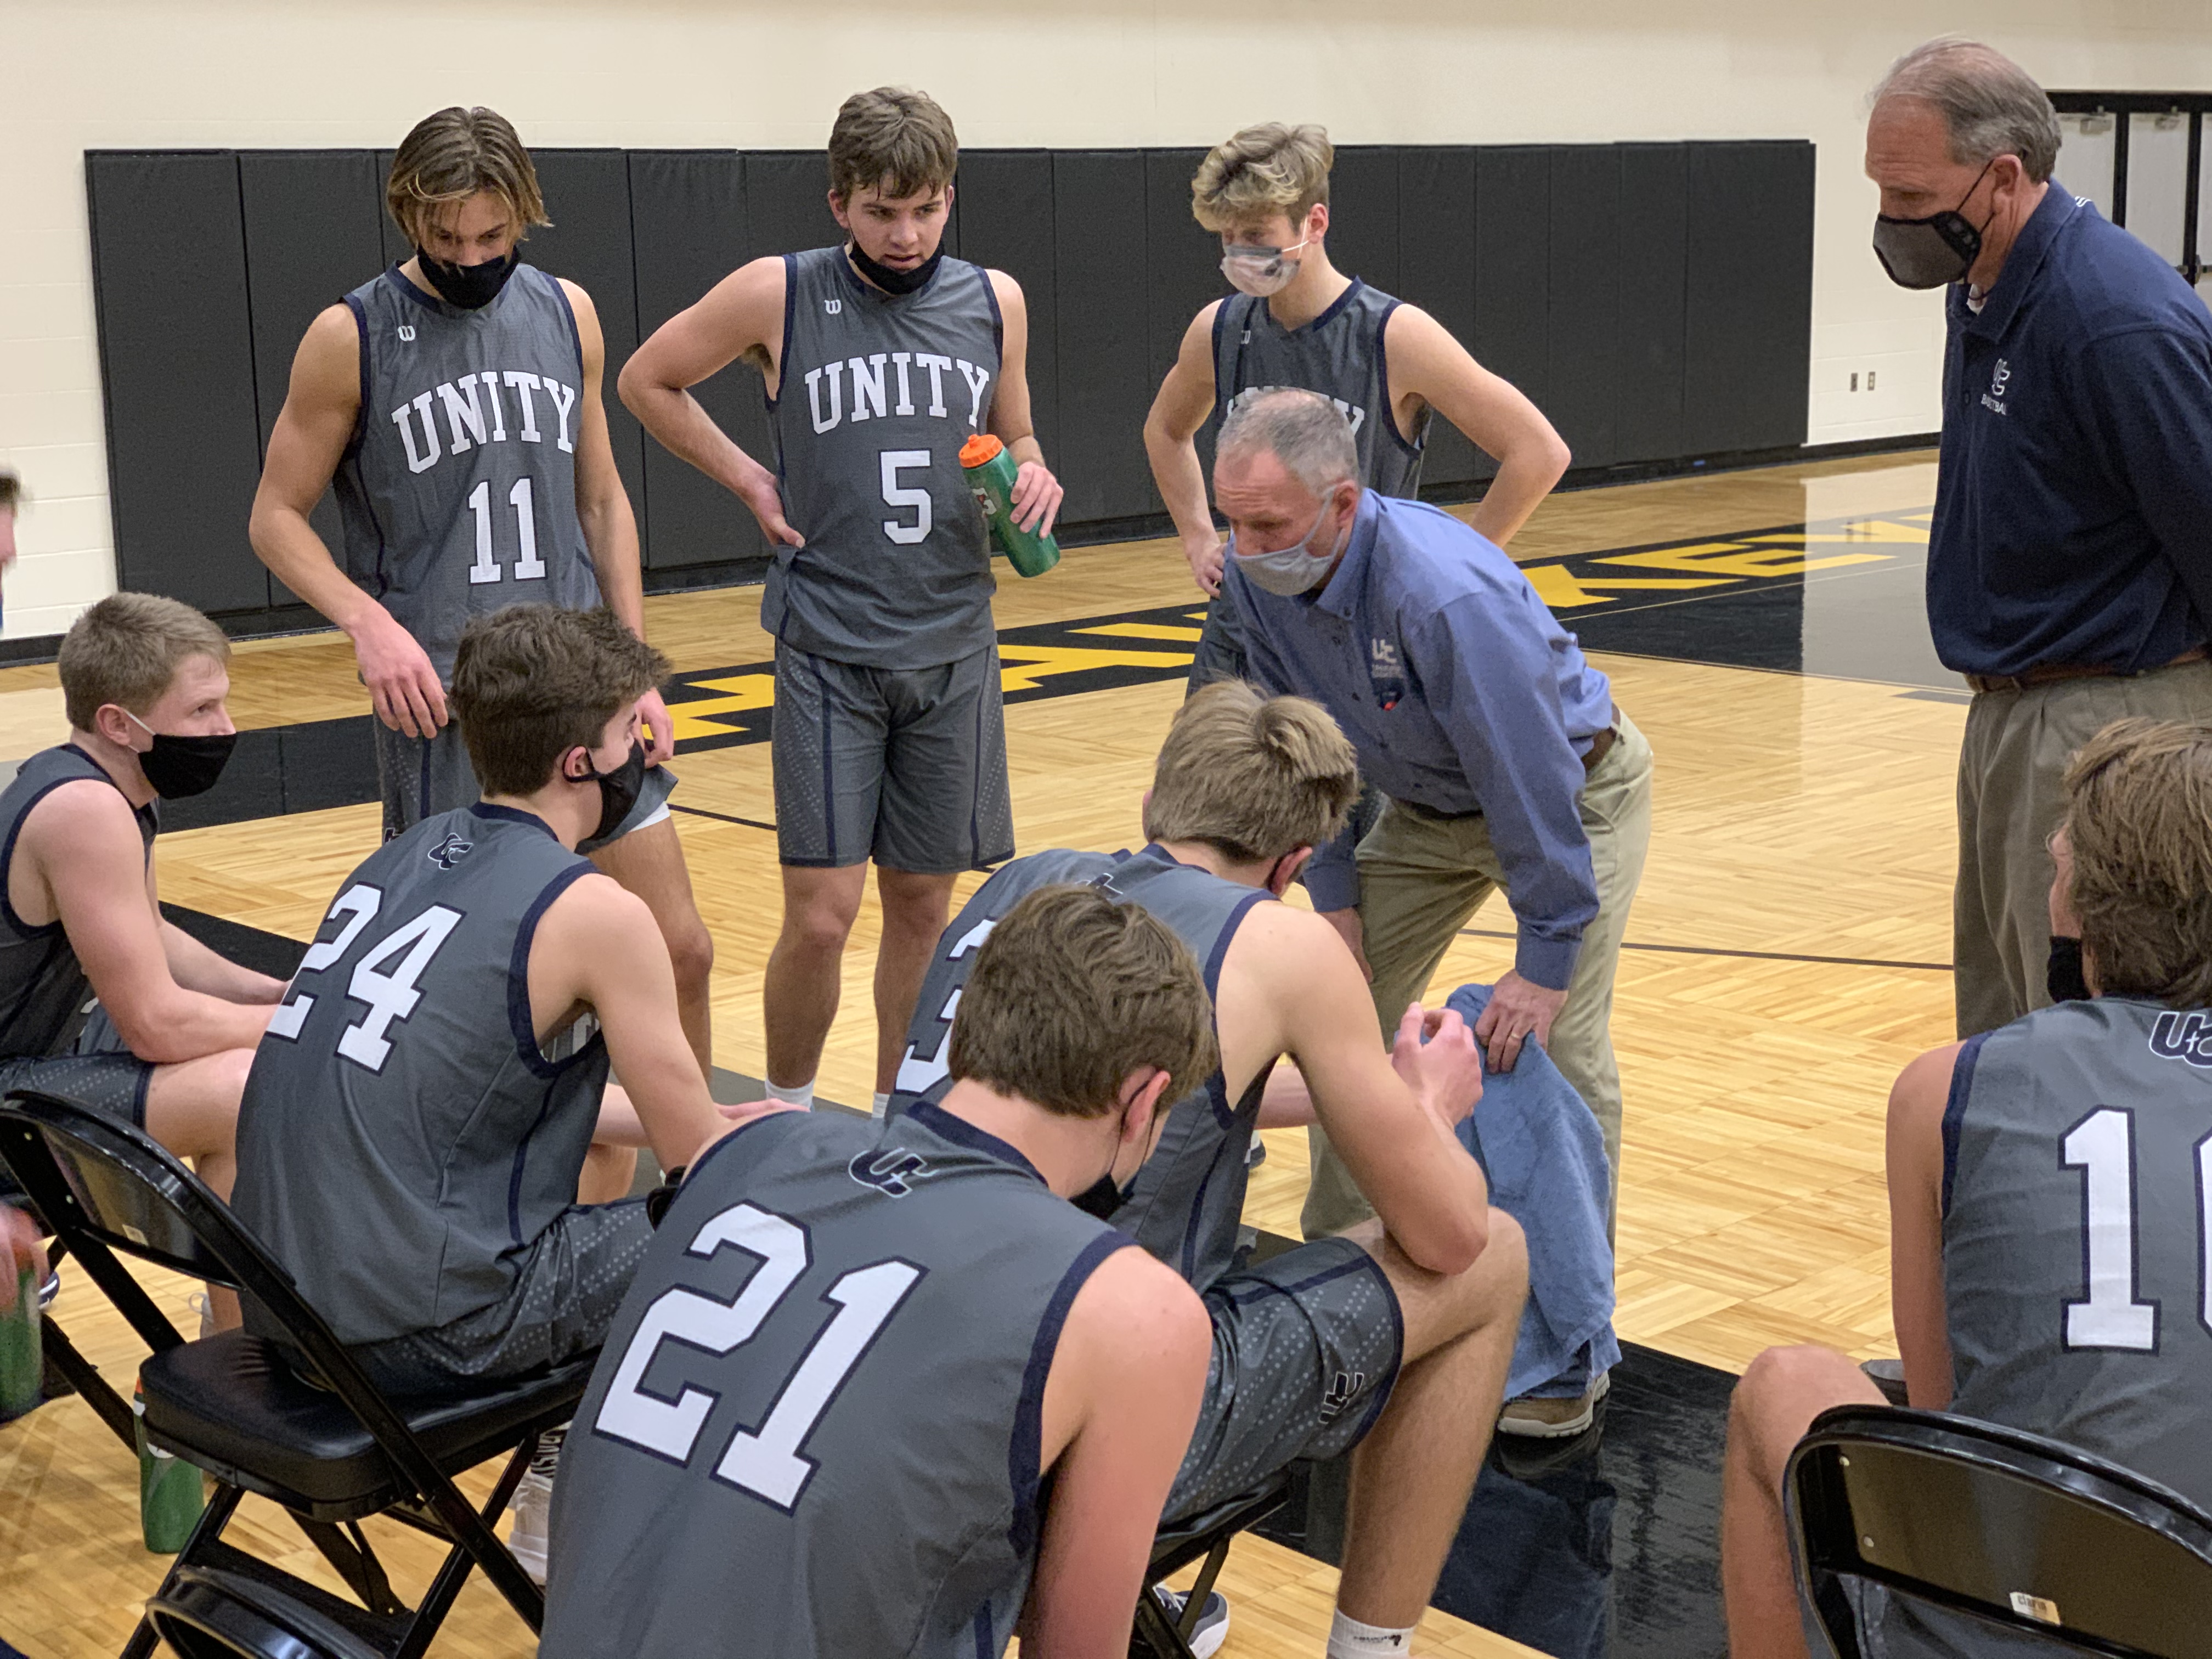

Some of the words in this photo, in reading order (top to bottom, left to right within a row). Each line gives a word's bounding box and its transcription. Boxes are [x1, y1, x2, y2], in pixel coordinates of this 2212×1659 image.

[391, 371, 575, 473] UNITY
[804, 352, 990, 435] UNITY
[467, 477, 546, 584] 11
[879, 449, 932, 545] 5
[264, 881, 467, 1076] 24
[2058, 1104, 2212, 1356] 1
[592, 1199, 930, 1516] 21
